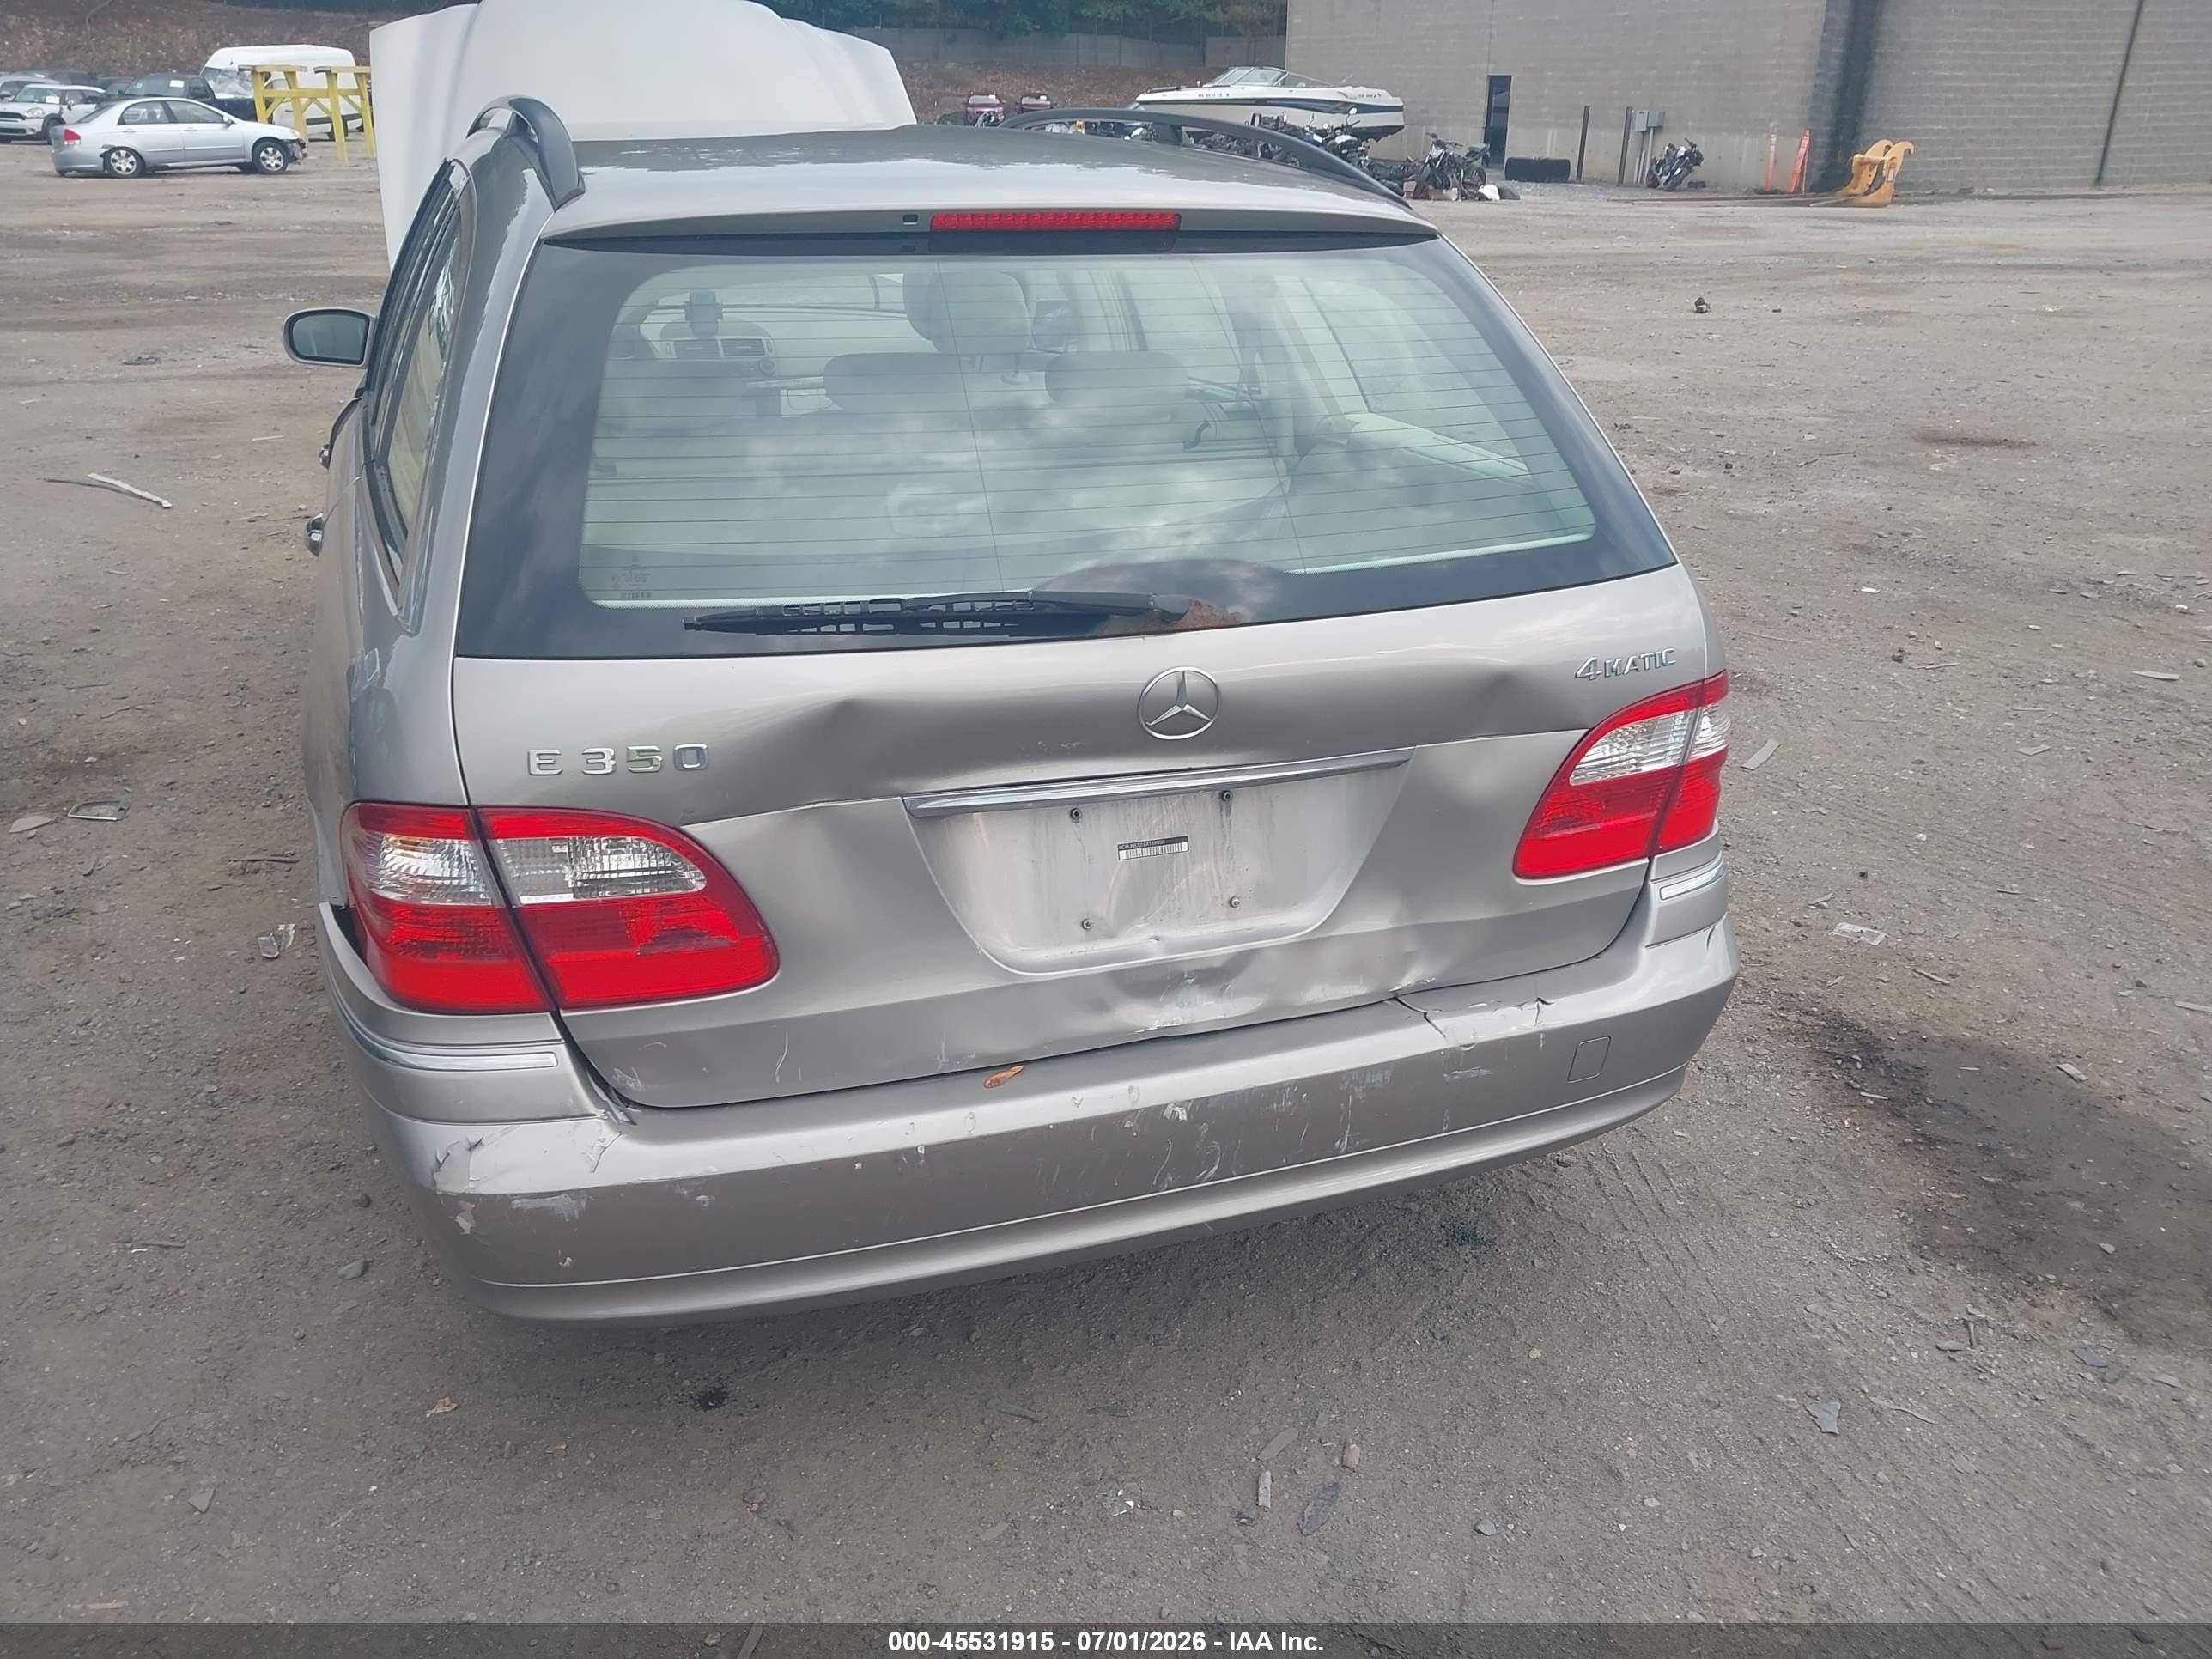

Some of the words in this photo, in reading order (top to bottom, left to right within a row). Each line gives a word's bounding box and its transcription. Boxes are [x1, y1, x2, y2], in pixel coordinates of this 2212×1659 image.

[1574, 647, 1676, 680] 4MATIC
[527, 748, 563, 775] E
[580, 743, 709, 775] 350
